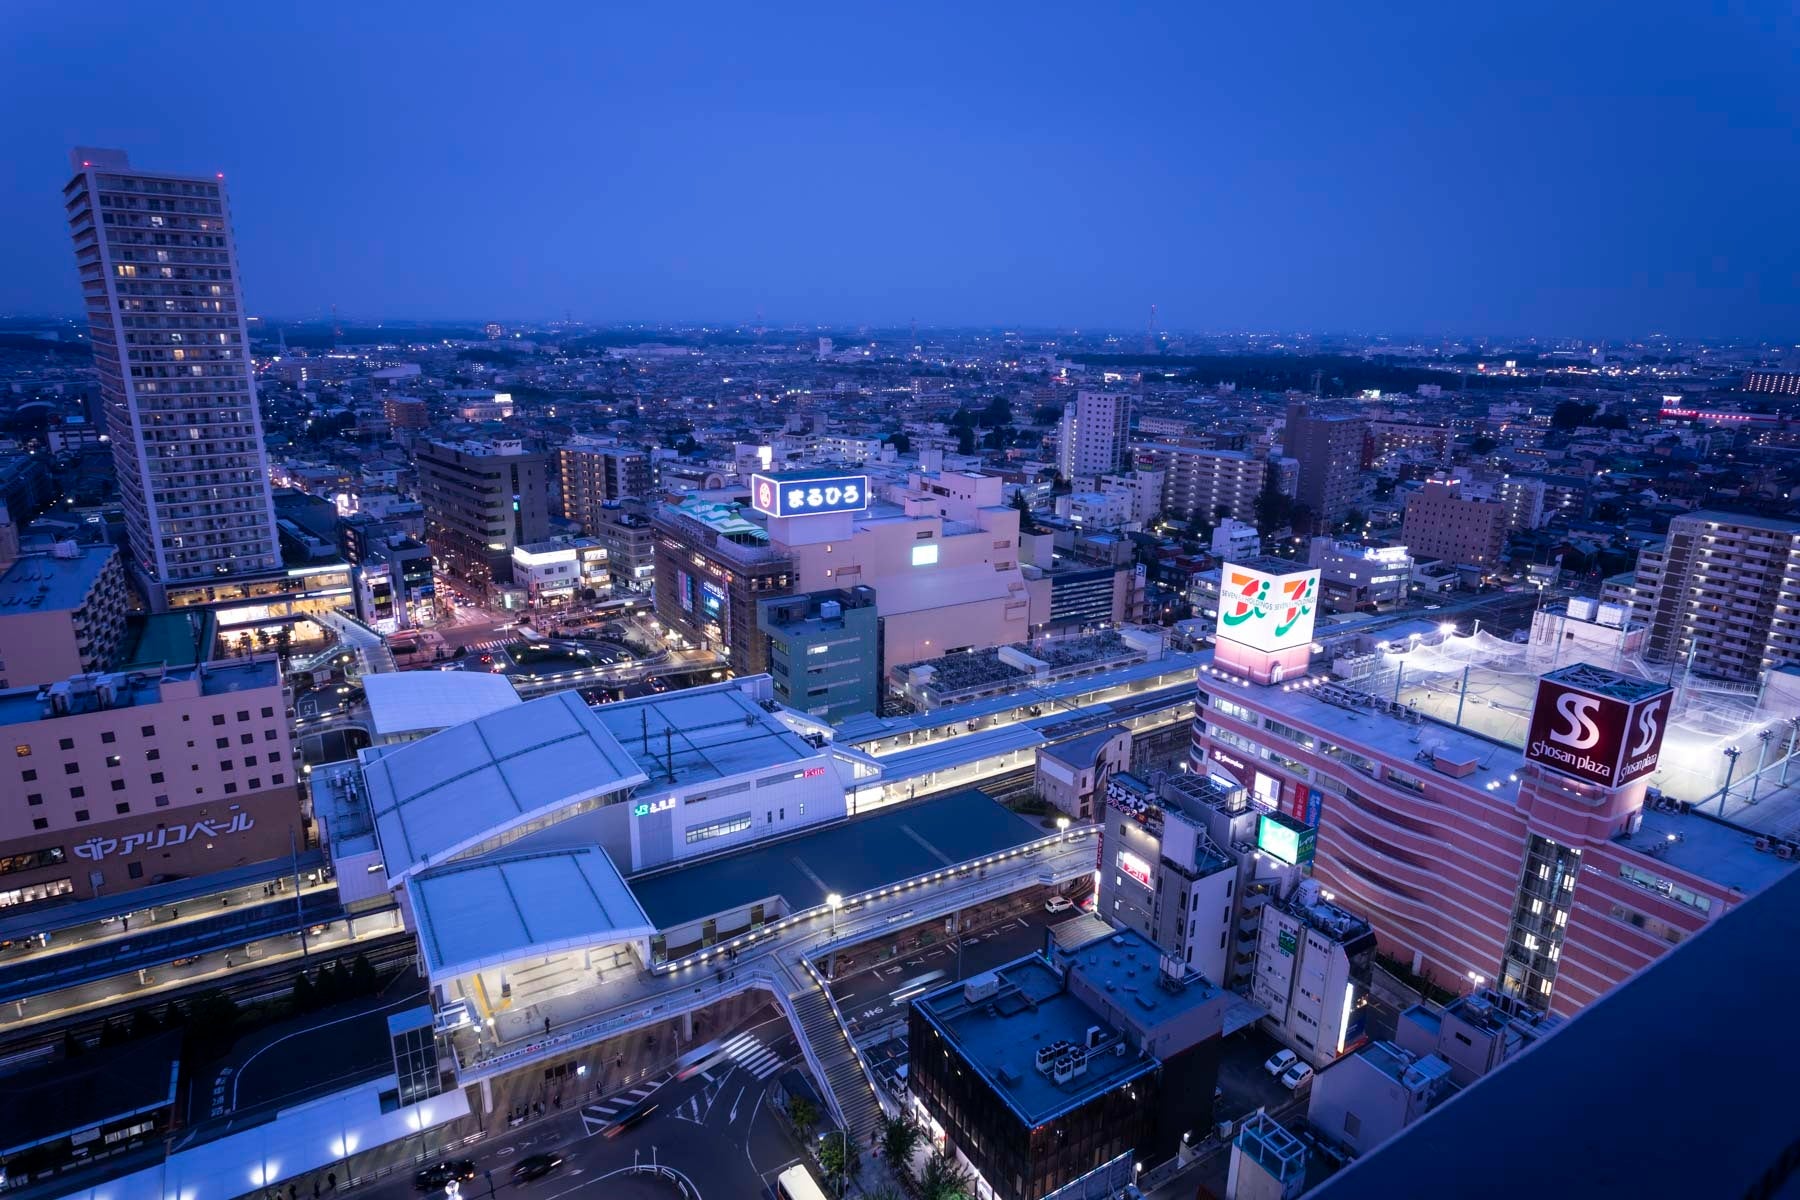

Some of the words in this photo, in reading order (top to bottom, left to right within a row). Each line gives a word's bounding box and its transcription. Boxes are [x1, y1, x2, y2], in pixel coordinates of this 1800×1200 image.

[788, 485, 859, 508] まるひろ
[1576, 755, 1611, 777] plaza
[1107, 783, 1149, 813] カラオケ
[119, 811, 255, 856] アリコベール
